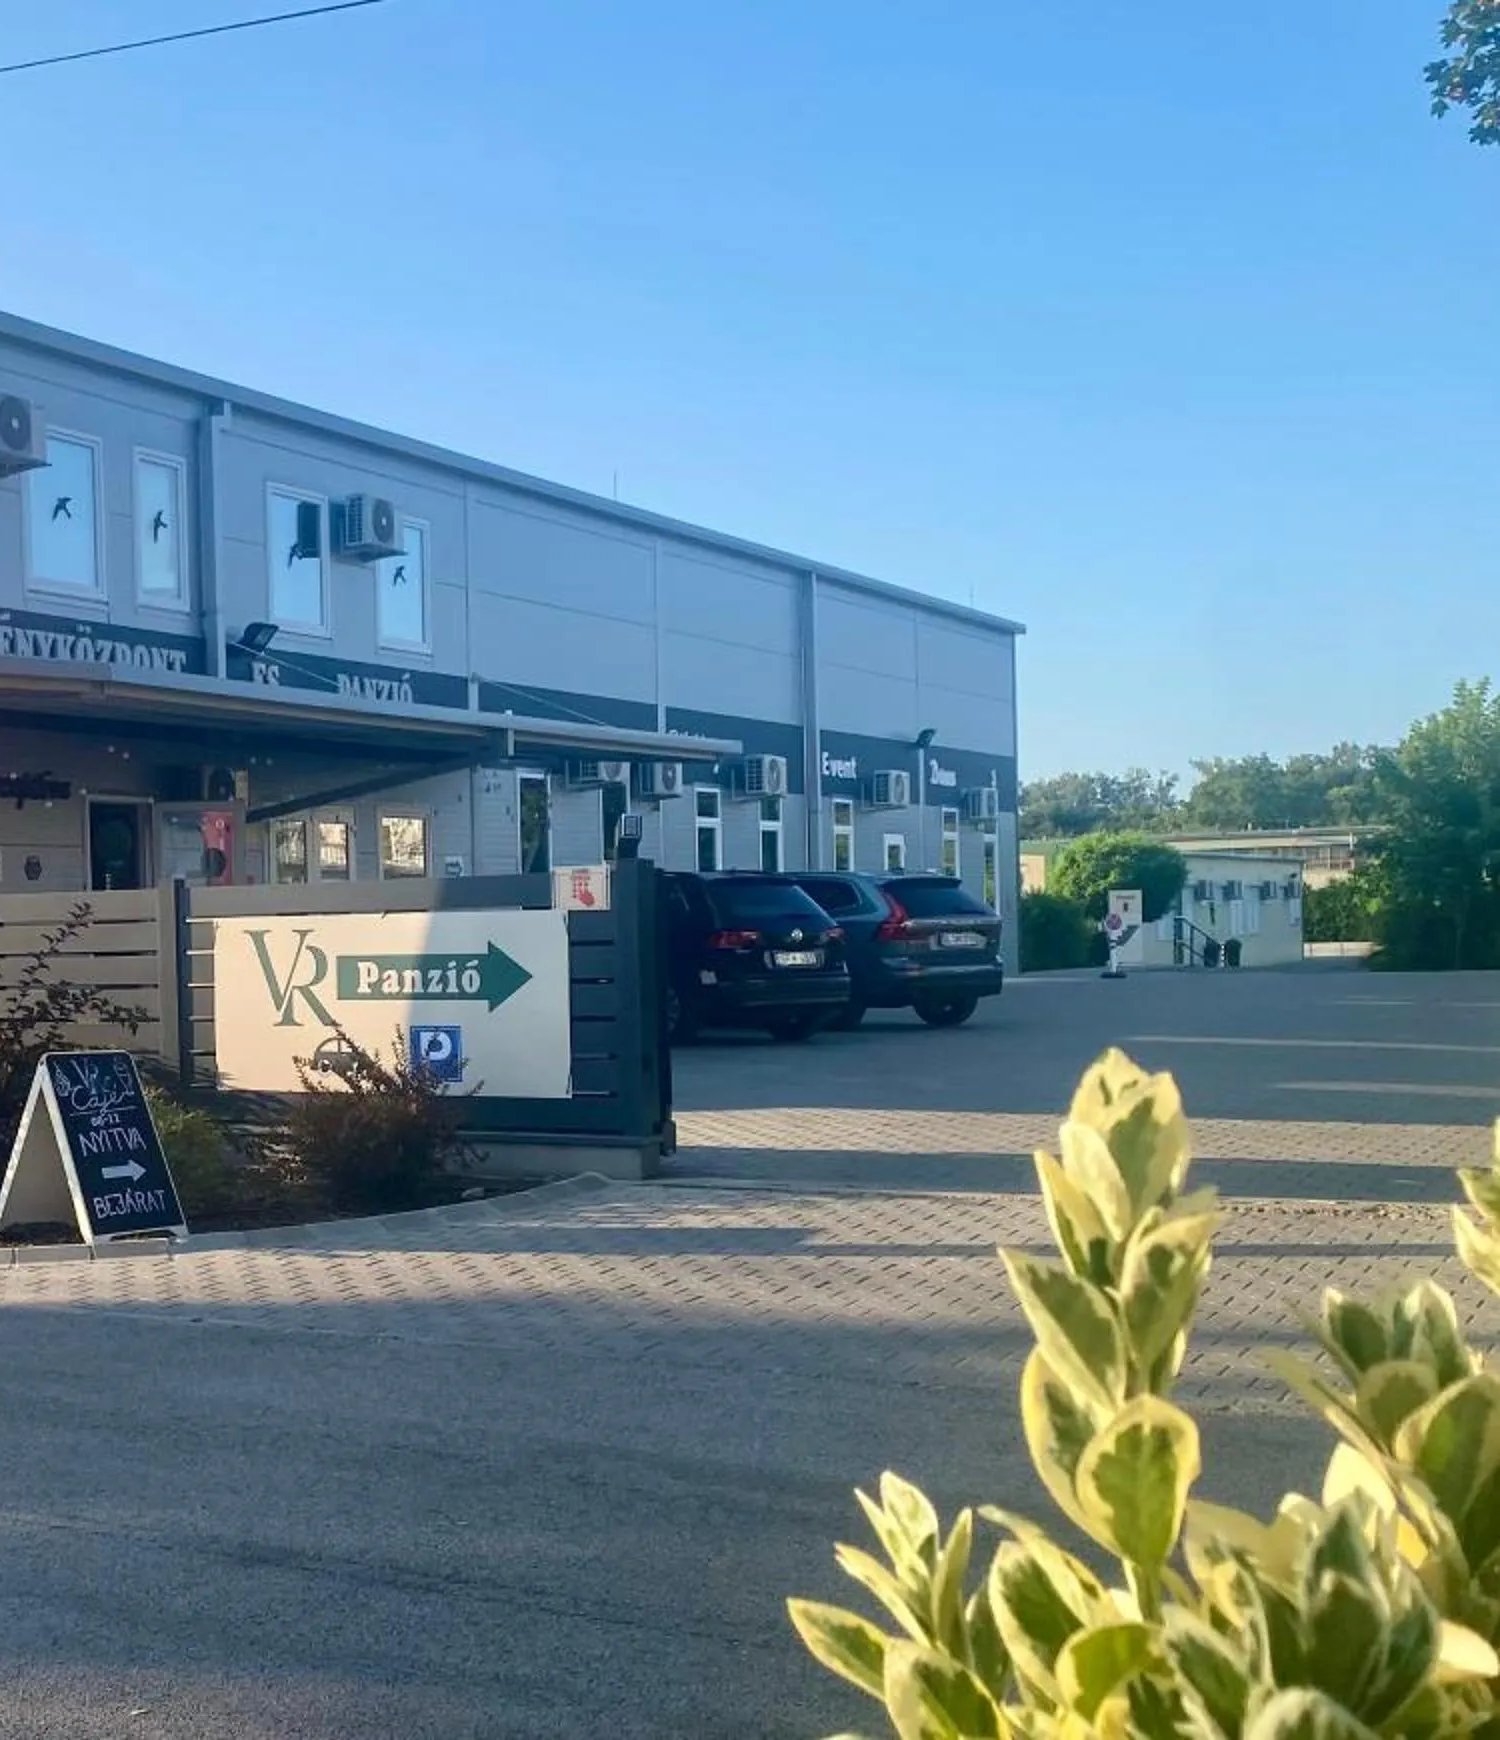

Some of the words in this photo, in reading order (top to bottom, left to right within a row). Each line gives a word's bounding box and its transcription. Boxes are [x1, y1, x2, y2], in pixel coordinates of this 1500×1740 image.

[821, 751, 857, 780] Event
[244, 929, 342, 1027] VR
[357, 958, 482, 994] Panzió
[78, 1126, 148, 1157] NYITVA
[93, 1187, 165, 1220] BEJÁRAT
